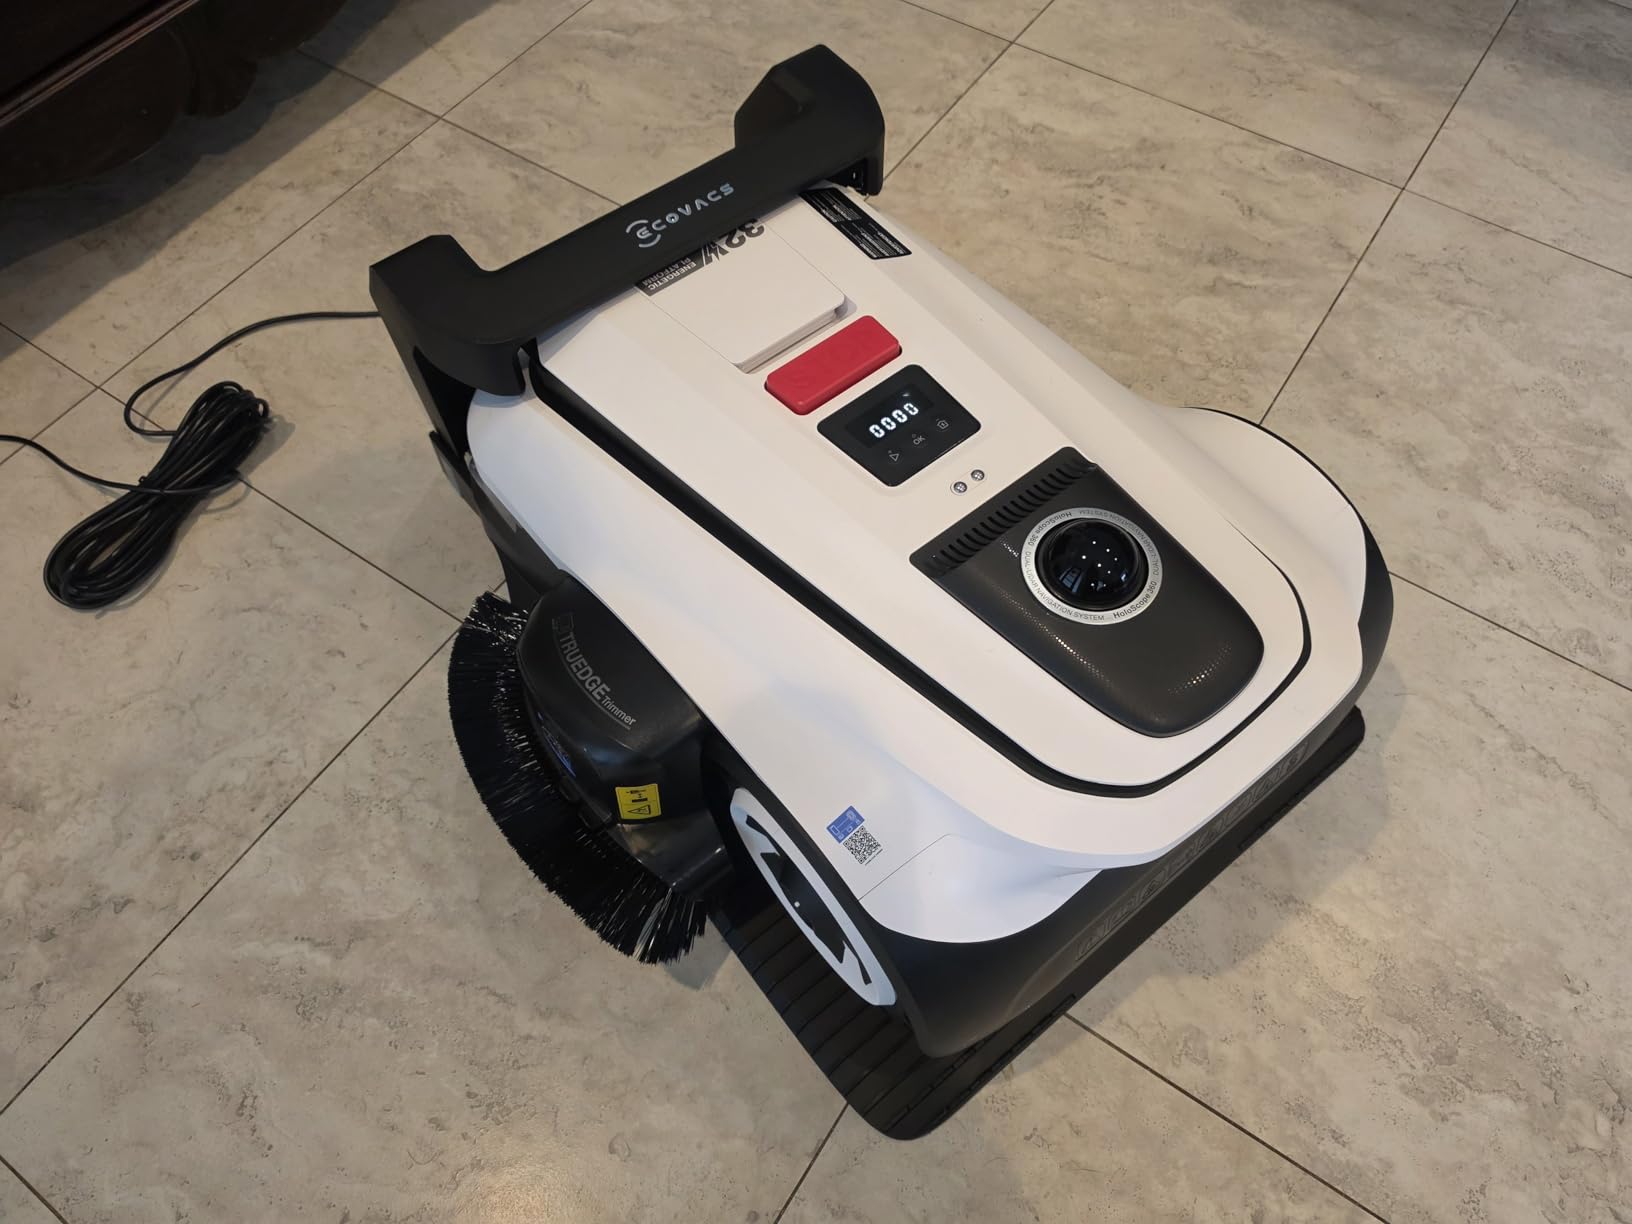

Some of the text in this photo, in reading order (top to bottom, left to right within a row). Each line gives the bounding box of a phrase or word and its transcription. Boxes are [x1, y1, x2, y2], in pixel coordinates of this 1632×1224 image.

[634, 183, 735, 241] ECOVACS
[642, 257, 692, 287] PLATFORM
[647, 261, 697, 291] ENERGETIC
[868, 402, 919, 438] 0000
[912, 435, 926, 445] OK
[1027, 511, 1073, 546] HoloScope 360
[1036, 587, 1073, 616] NAVIGATION
[1073, 611, 1105, 621] SYSTEM
[1112, 580, 1158, 619] HoloScope 360
[559, 631, 637, 726] TRUEDGE Trimmer
